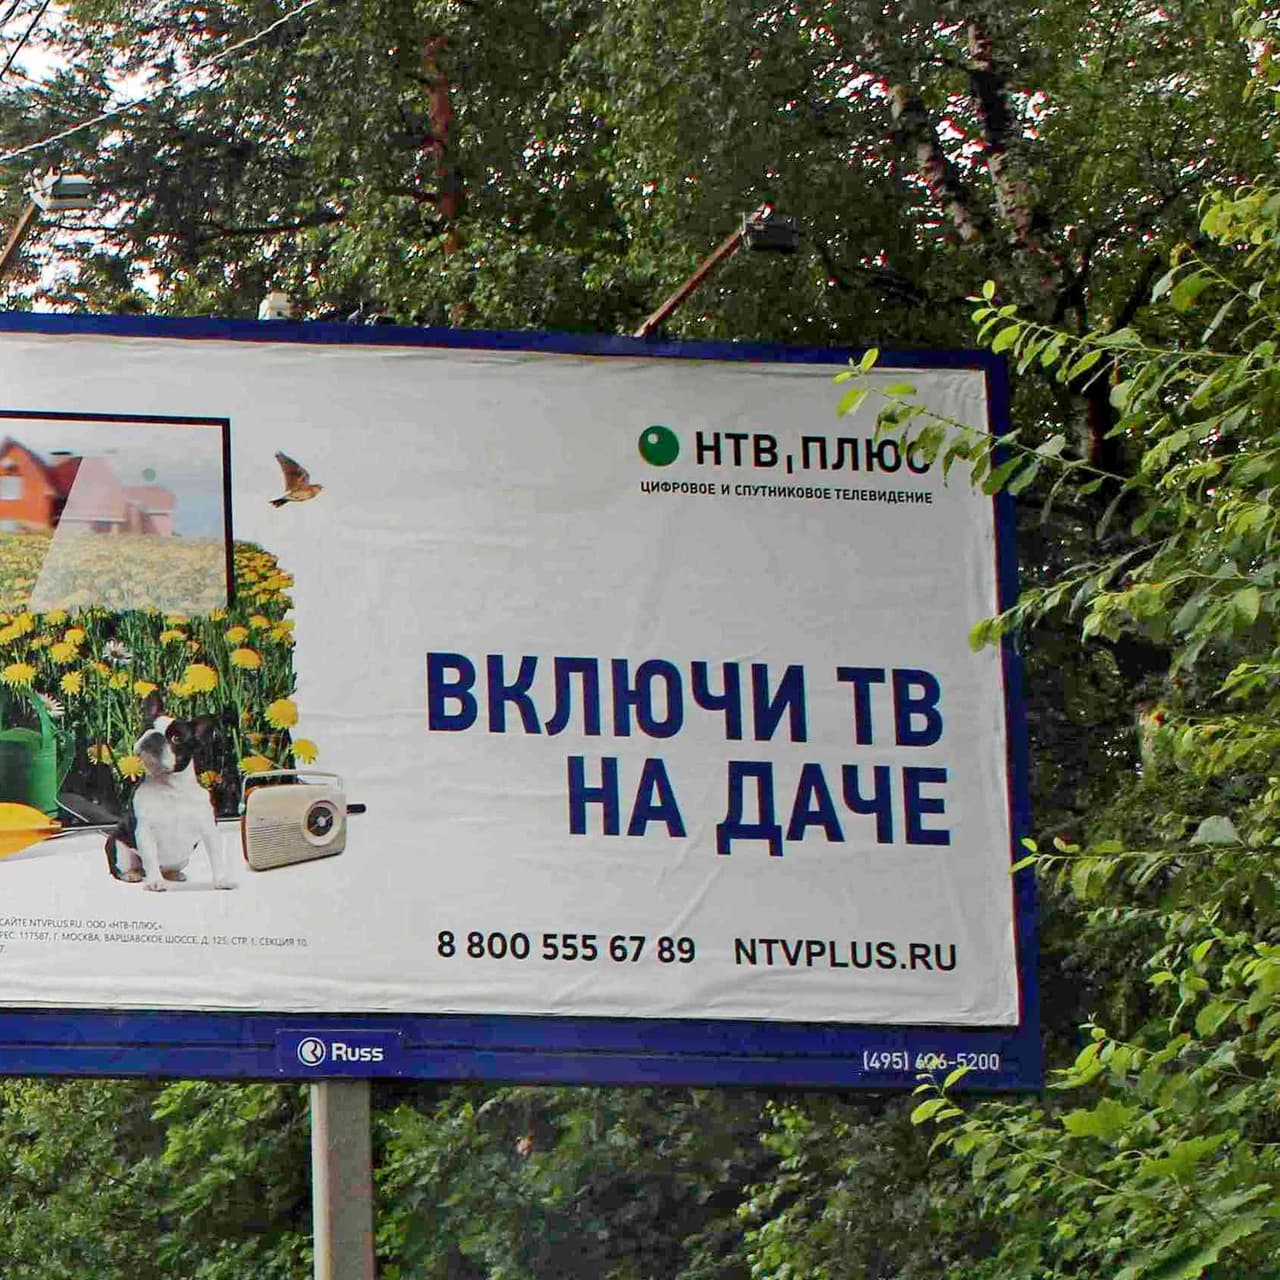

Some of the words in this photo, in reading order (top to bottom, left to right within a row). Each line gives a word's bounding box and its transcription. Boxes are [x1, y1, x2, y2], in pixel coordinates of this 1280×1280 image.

[640, 480, 716, 495] ЦИФРОВОЕ
[721, 484, 730, 495] И
[734, 484, 831, 500] СПУТНИКОВОЕ
[834, 488, 933, 504] ТЕЛЕВИДЕНИЕ
[425, 651, 807, 743] ВКЛЮЧИ
[836, 666, 944, 748] ТВ
[566, 755, 688, 839] НА
[715, 759, 952, 857] ДАЧЕ
[437, 930, 456, 959] 8
[466, 931, 530, 960] 800
[541, 933, 598, 962] 555
[609, 935, 646, 963] 67
[657, 936, 696, 964] 89
[734, 937, 957, 972] NTVPLUS.RU
[331, 1042, 384, 1062] Russ
[863, 1050, 909, 1071] (495)
